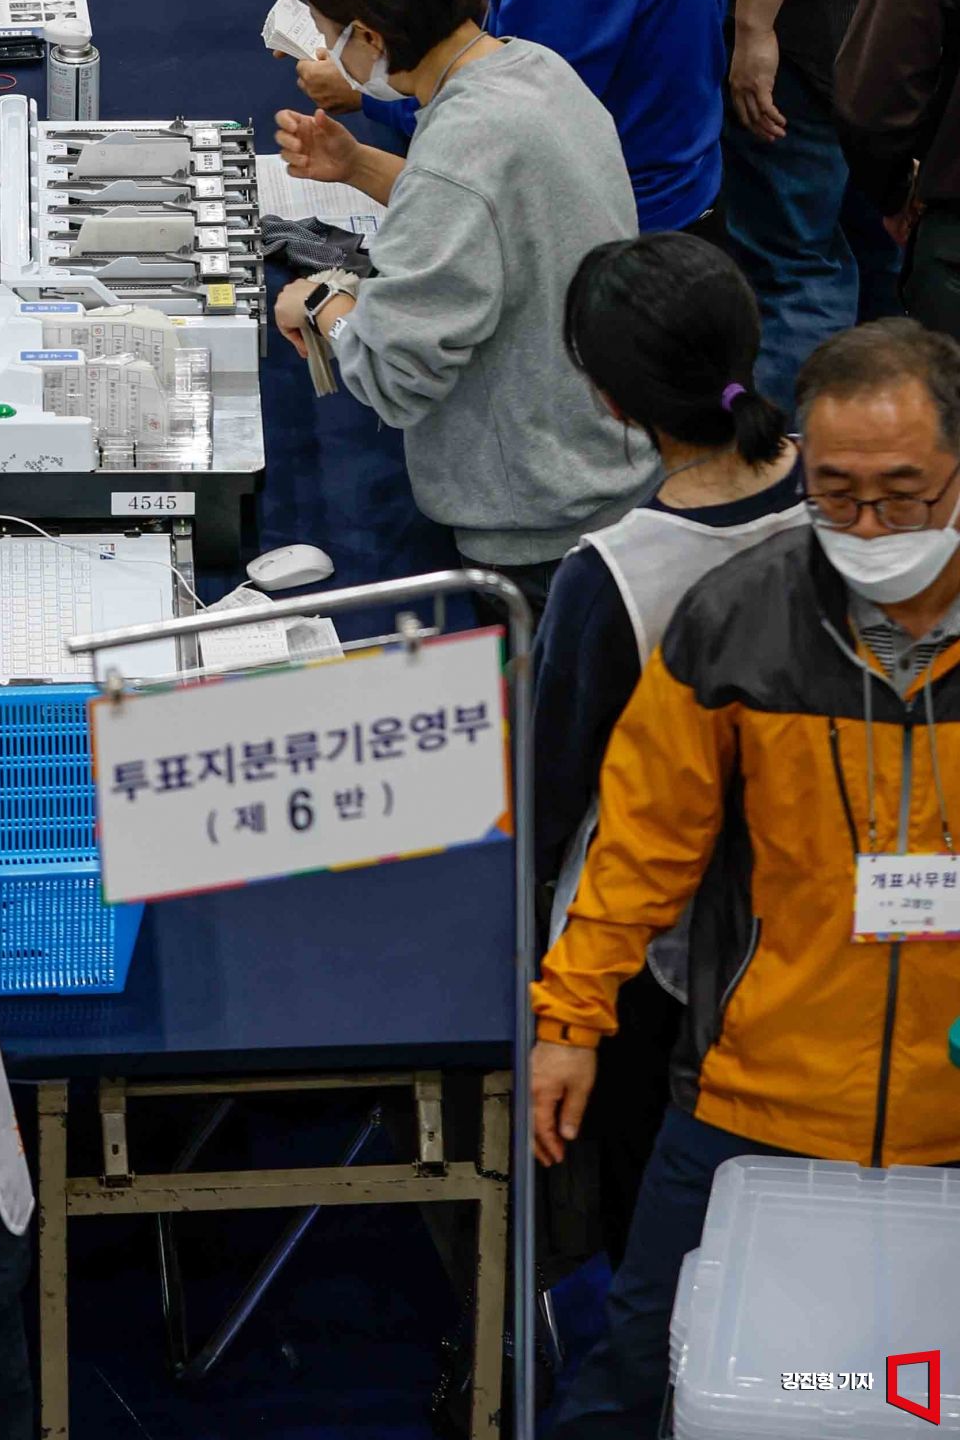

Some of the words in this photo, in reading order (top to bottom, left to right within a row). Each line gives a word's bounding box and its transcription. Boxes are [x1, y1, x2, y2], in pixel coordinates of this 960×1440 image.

[128, 495, 177, 510] 4545
[111, 701, 491, 803] 투표지분류기운영부
[287, 788, 315, 831] 6
[871, 871, 957, 889] 개표사무원
